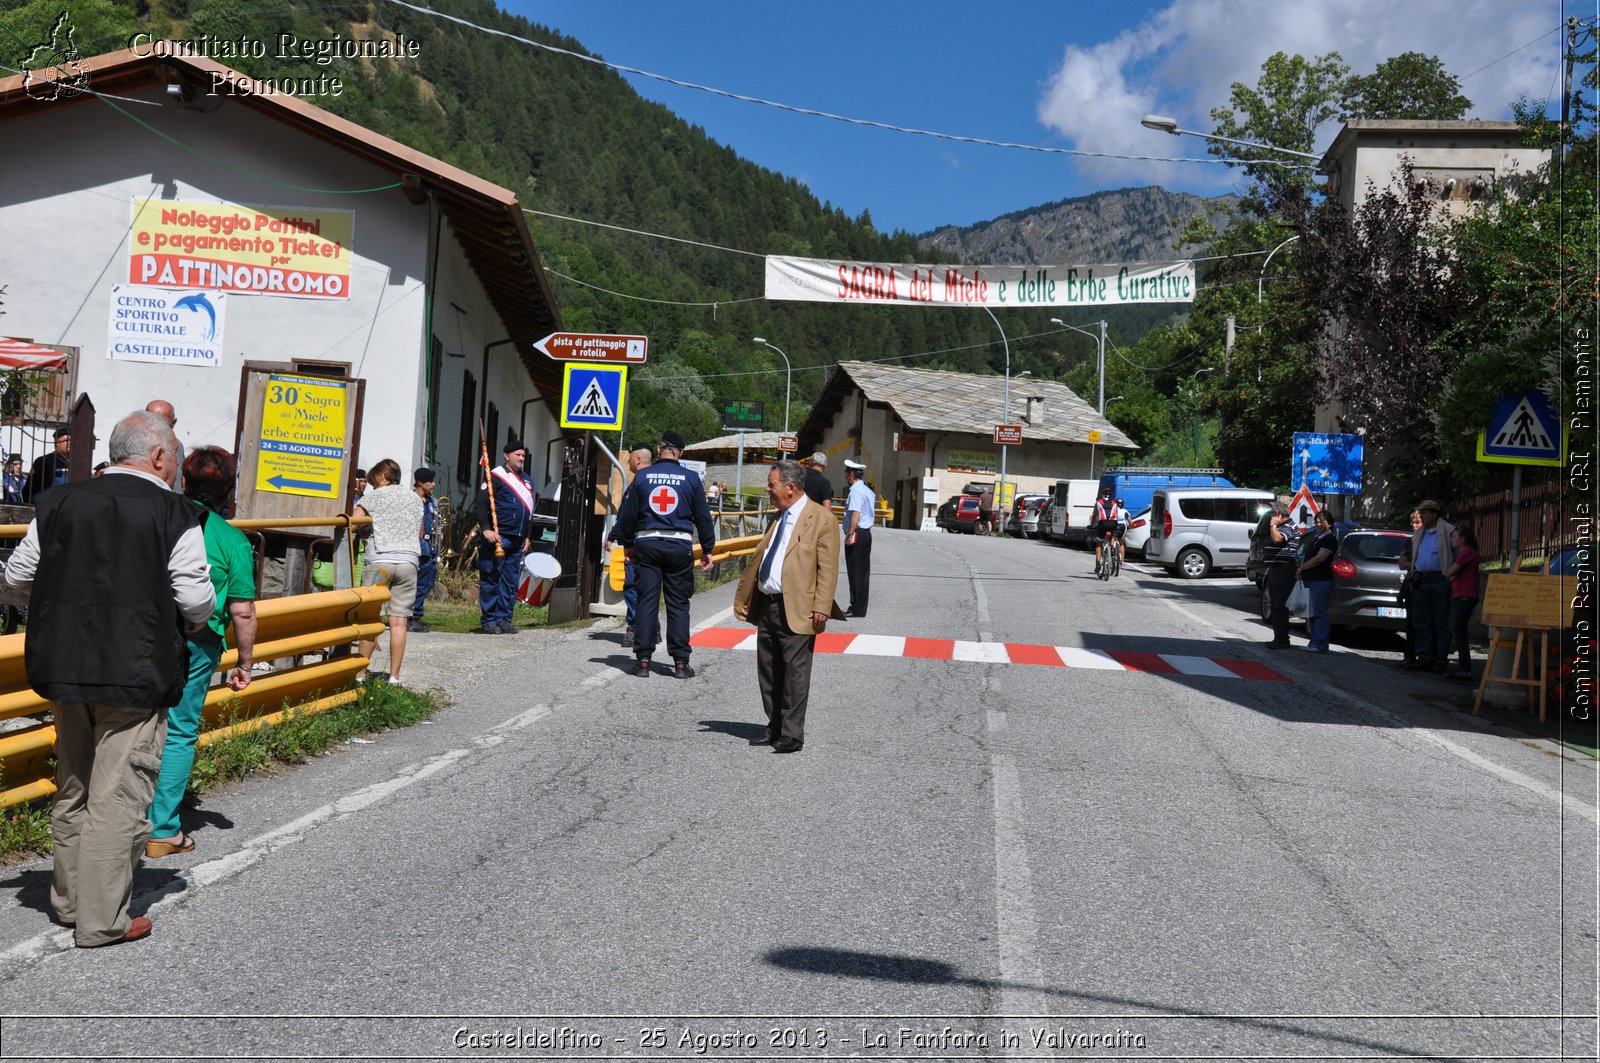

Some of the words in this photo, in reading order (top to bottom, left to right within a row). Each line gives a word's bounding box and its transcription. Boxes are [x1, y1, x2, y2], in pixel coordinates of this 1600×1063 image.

[161, 208, 251, 235] Noleggio
[254, 215, 320, 235] Pattini
[137, 233, 150, 246] e
[154, 231, 274, 254] pagamento
[279, 237, 342, 259] Ticket
[271, 255, 291, 266] per
[141, 255, 343, 295] PATTINODROMO
[838, 264, 899, 301] SAGRA
[909, 268, 933, 302] del
[944, 268, 988, 303] Miele
[999, 280, 1007, 303] e
[1017, 269, 1056, 303] delle
[1067, 268, 1107, 301] Erbe
[1117, 266, 1190, 301] Curative
[117, 296, 166, 309] CENTRO
[116, 309, 179, 323] SPORTIVO
[115, 321, 187, 336] CULTURALE
[114, 343, 214, 359] CASTELDELFINO
[553, 338, 573, 347] pista
[575, 338, 582, 347] di
[583, 338, 626, 350] pattinaggio
[579, 348, 607, 358] rotelle
[304, 392, 341, 409] Sagra
[294, 408, 328, 422] Miele
[298, 421, 314, 429] delle
[263, 426, 290, 439] erbe
[294, 431, 342, 444] curative
[288, 445, 322, 455] AGOSTO
[323, 448, 341, 457] 2013
